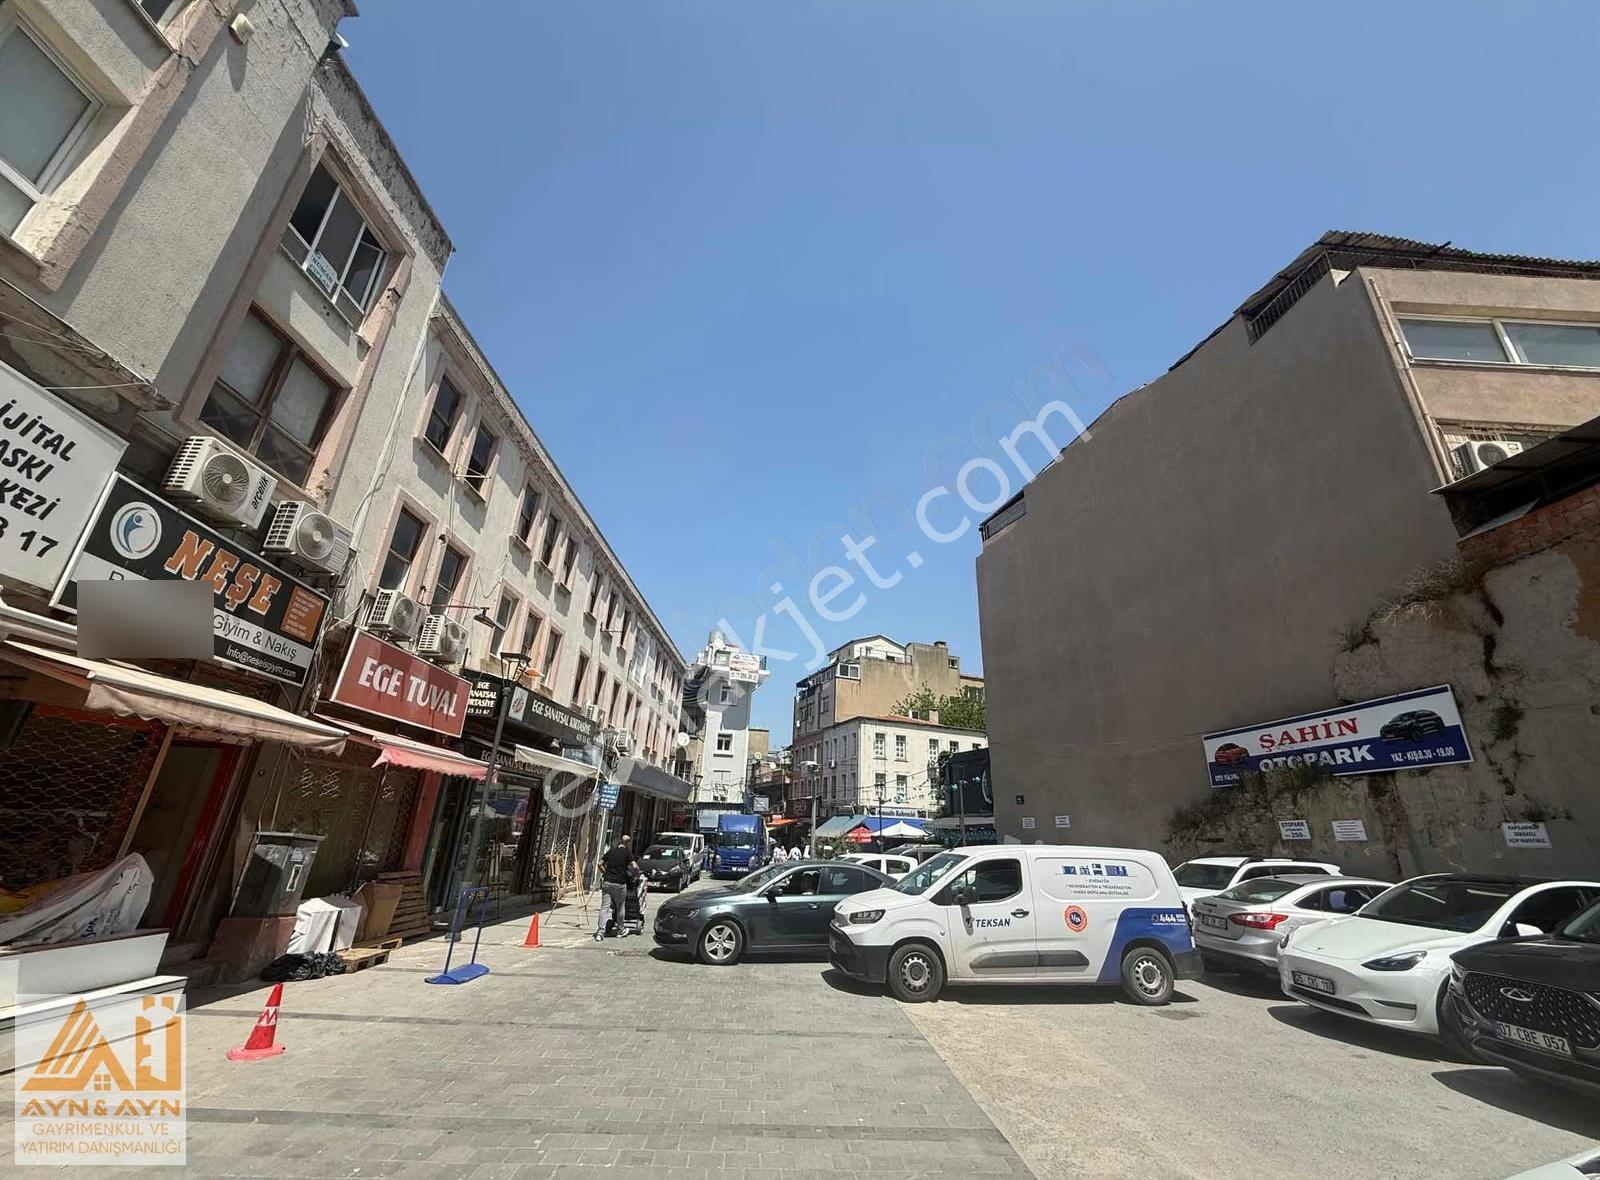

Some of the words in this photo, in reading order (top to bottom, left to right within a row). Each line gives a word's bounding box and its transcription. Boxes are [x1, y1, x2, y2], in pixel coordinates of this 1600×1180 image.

[0, 399, 76, 462] İJİTAL
[0, 439, 54, 483] ASKI
[0, 478, 61, 521] KEZİ
[20, 530, 59, 559] 17
[163, 530, 282, 616] NEŞE
[214, 614, 250, 640] Giyim
[252, 631, 262, 646] &
[265, 635, 297, 662] Nakış
[357, 656, 404, 697] EGE
[408, 669, 458, 718] TUVAL
[477, 681, 490, 690] EGE
[531, 699, 545, 716] EGE
[543, 704, 569, 727] SANATSAL
[1258, 716, 1359, 752] ŞAHİN
[1259, 744, 1376, 773] OTOPARK
[975, 917, 1011, 928] TEKSAN
[1516, 1026, 1540, 1045] CBE
[1542, 1034, 1569, 1053] 052
